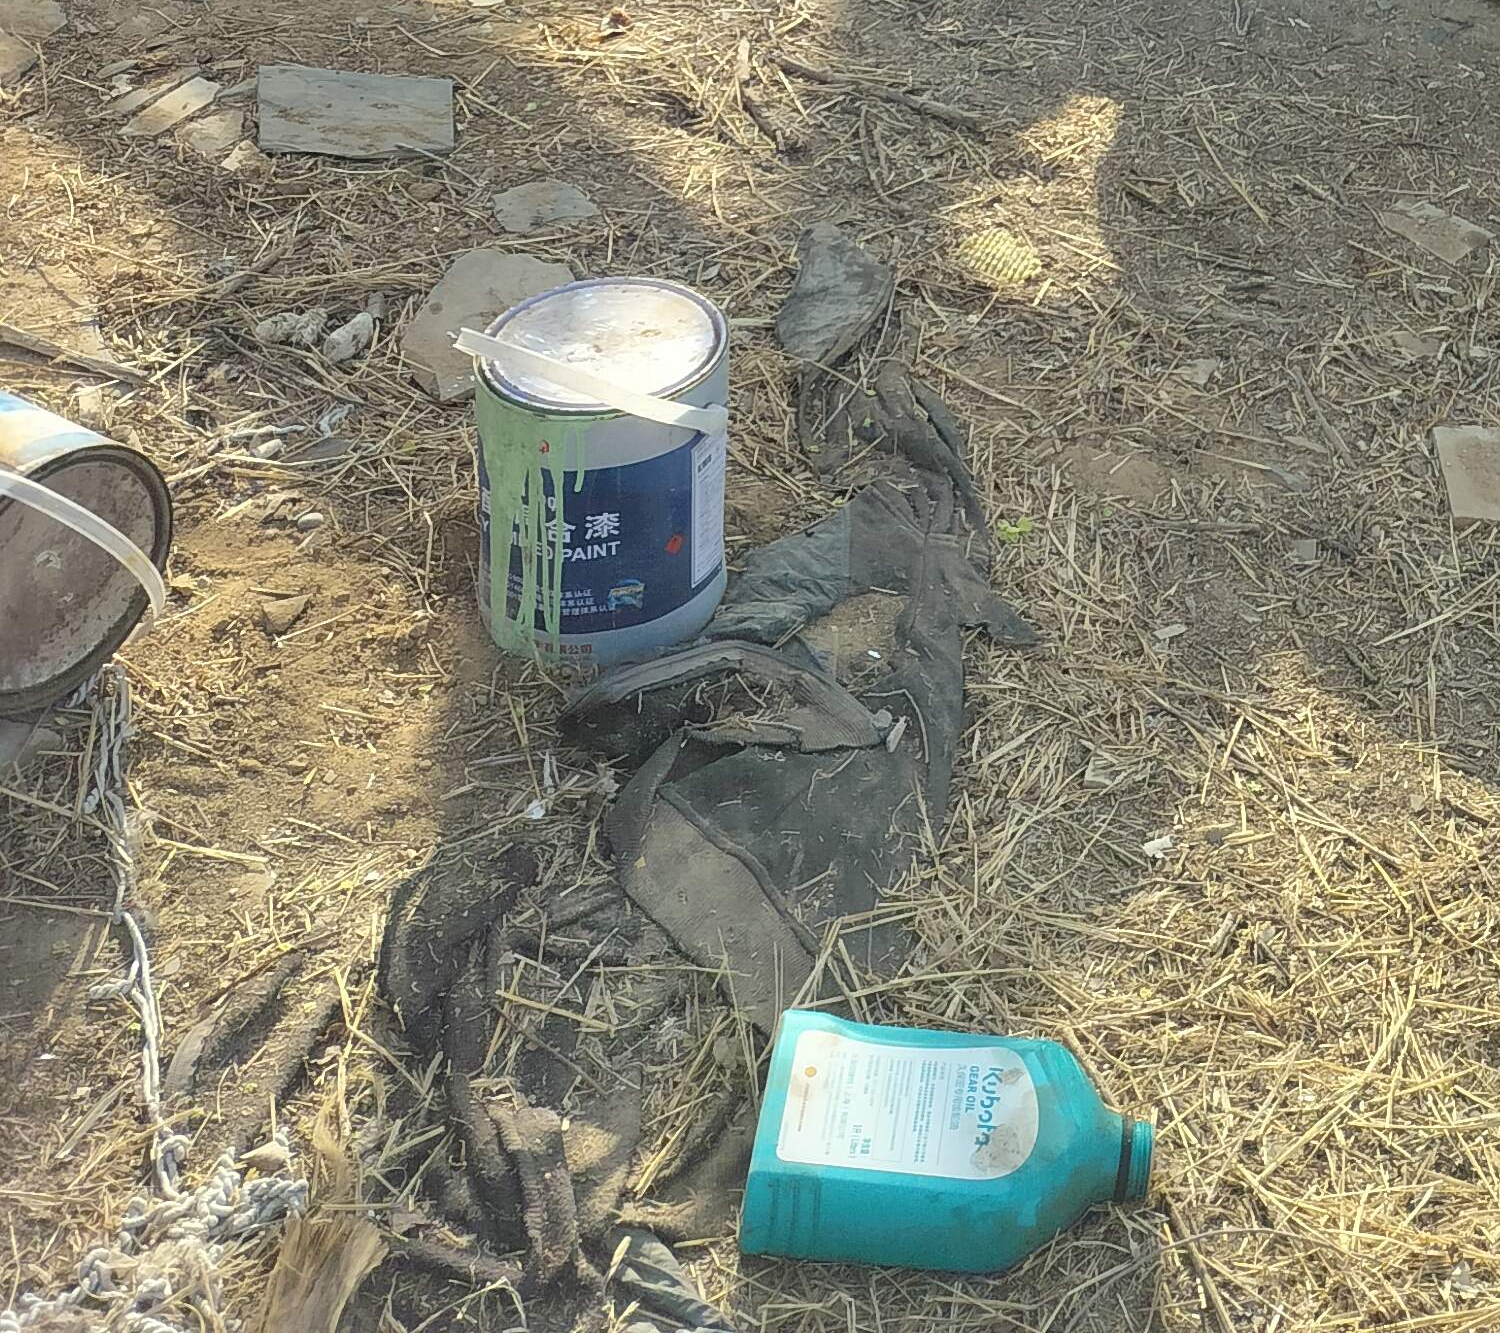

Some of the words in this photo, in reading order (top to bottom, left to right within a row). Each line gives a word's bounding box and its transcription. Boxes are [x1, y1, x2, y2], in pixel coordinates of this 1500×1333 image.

[562, 541, 621, 562] PAINT
[967, 1065, 980, 1093] GEAR
[965, 1095, 976, 1113] OIL
[974, 1067, 1004, 1145] Kubota
